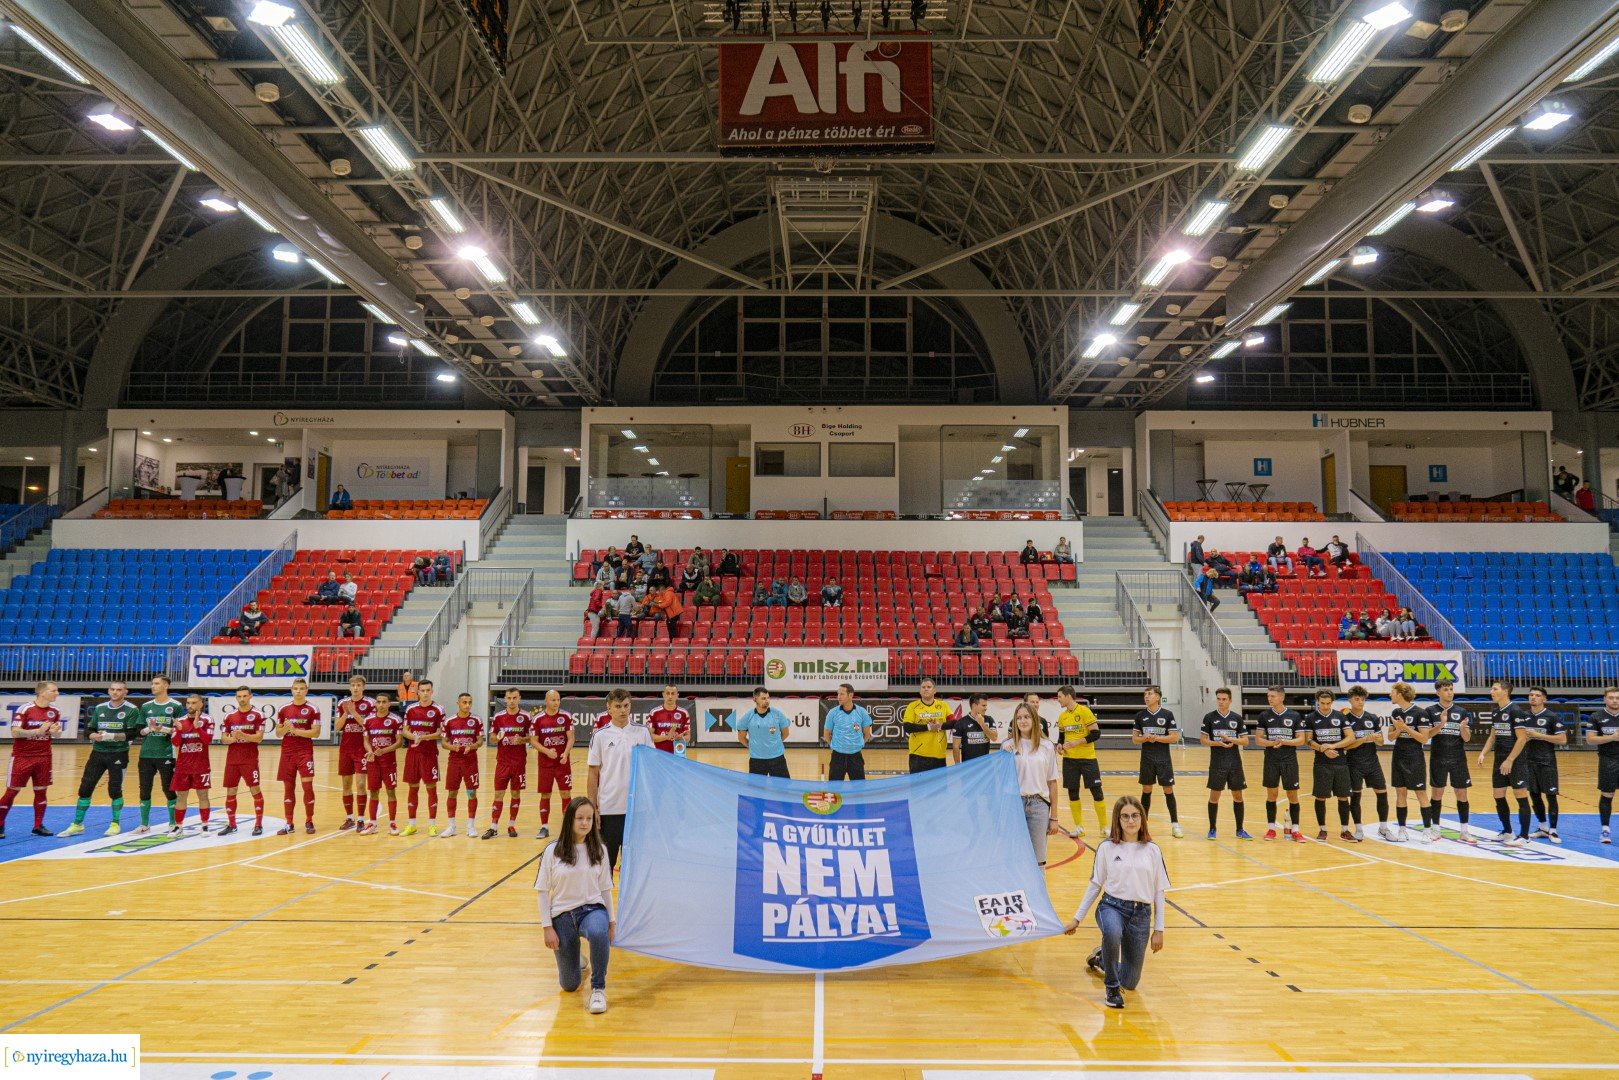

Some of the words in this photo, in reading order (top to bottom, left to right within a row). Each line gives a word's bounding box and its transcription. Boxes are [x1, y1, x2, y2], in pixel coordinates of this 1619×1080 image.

[738, 42, 902, 116] Alfi
[728, 127, 762, 140] Ahol
[766, 131, 773, 139] a
[777, 126, 820, 142] pénze
[824, 126, 872, 139] többet
[875, 125, 896, 138] ér!
[290, 415, 335, 423] NYÍREGYHÁZA
[1330, 417, 1386, 428] HÜBNER
[793, 425, 811, 436] BH
[793, 659, 887, 673] mlsz.hu
[252, 770, 259, 779] 8
[431, 766, 438, 775] 6
[470, 772, 479, 783] 17
[762, 822, 778, 841] A
[782, 823, 887, 847] GYŰLÖLET
[762, 843, 894, 898] NEM
[977, 894, 1023, 910] FAIR
[980, 903, 1025, 917] PLAY
[762, 897, 898, 938] PÁLYA!
